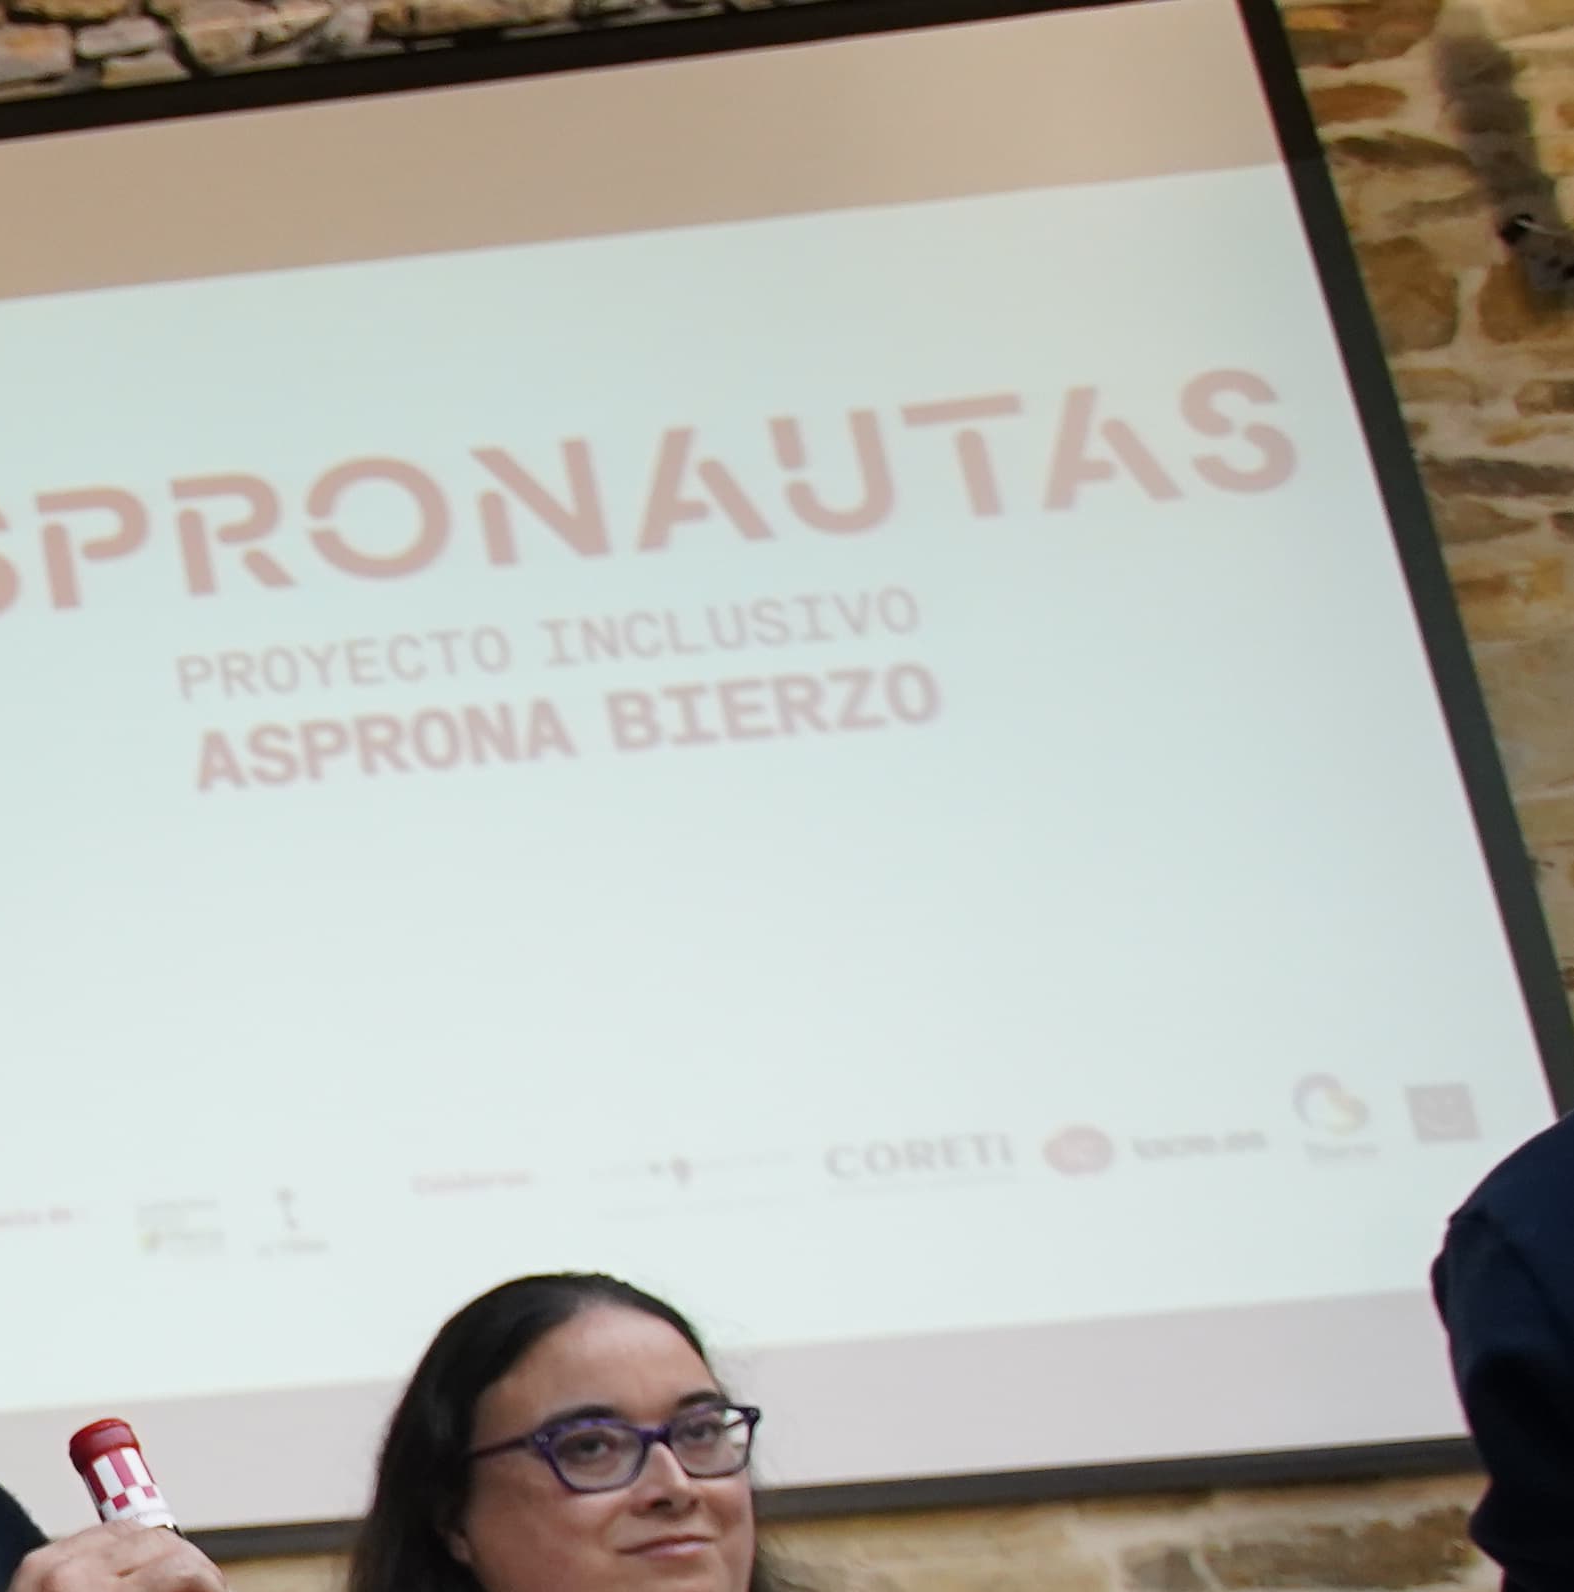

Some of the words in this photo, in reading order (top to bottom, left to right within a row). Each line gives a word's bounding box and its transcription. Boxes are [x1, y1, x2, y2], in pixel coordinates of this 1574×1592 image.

[176, 625, 510, 702] PROYECTO
[542, 585, 922, 668] INCLUSIVO
[196, 699, 575, 793] ASPRONA
[607, 662, 941, 753] BIERZO
[827, 1132, 1014, 1179] CORETI
